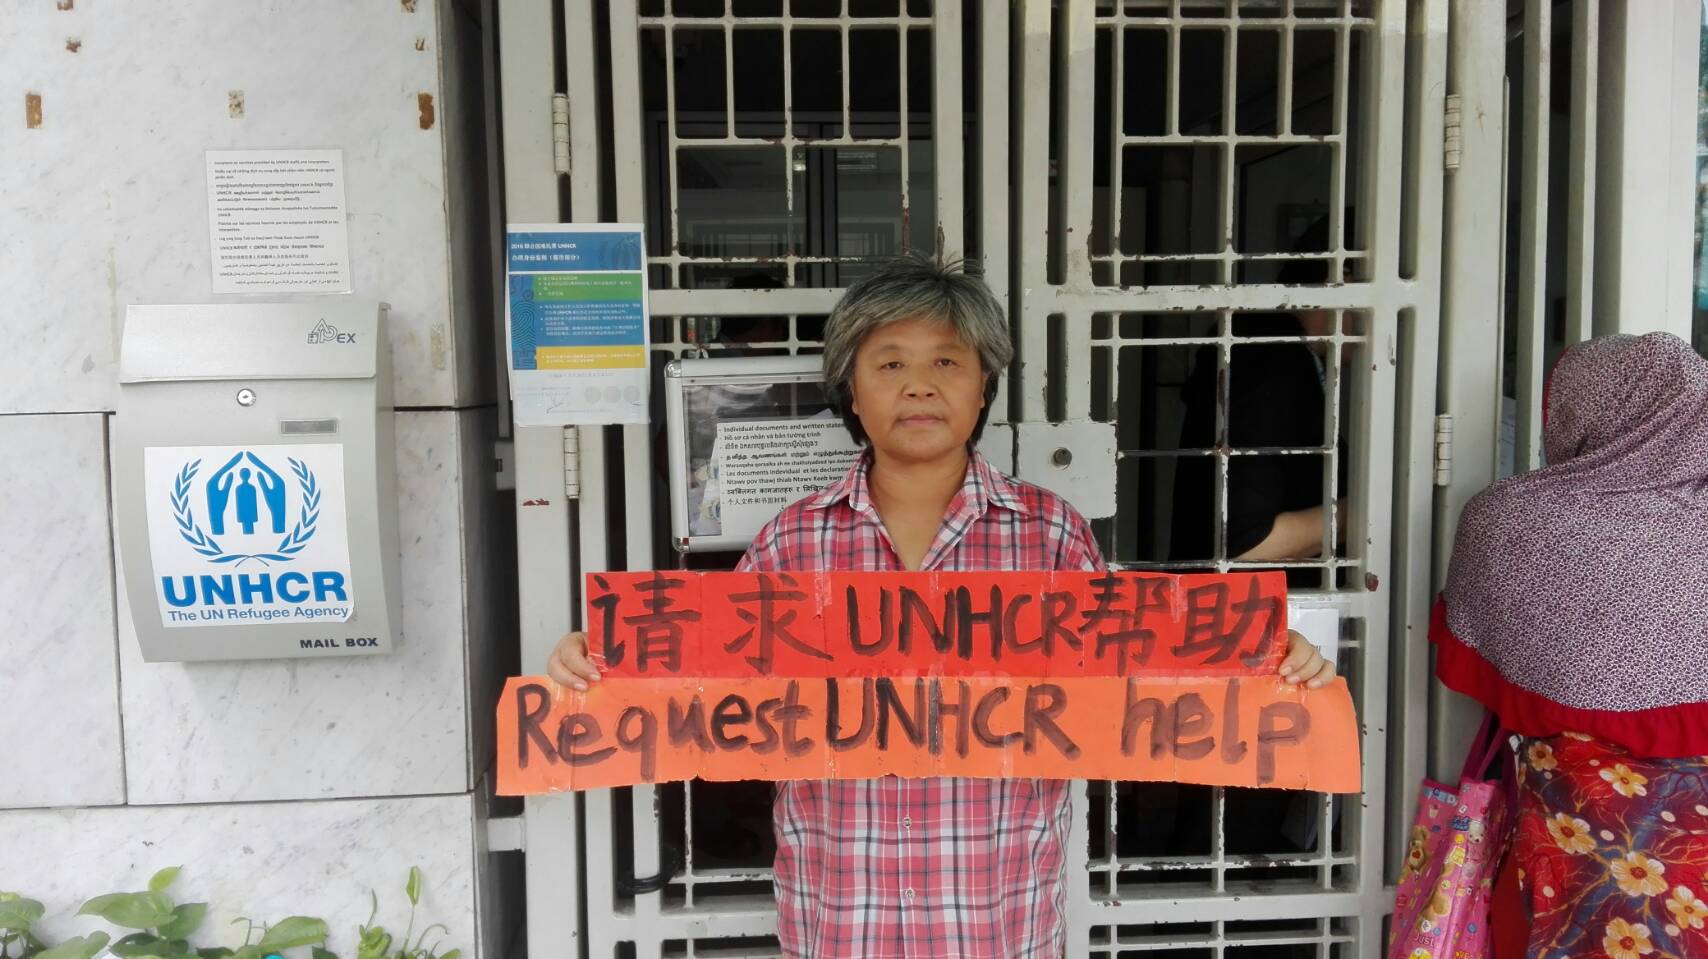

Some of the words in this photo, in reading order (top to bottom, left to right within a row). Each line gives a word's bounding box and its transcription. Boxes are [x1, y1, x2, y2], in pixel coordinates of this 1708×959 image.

[161, 570, 348, 608] UNHCR
[168, 609, 198, 622] The
[200, 608, 224, 620] UN
[227, 607, 290, 621] Refugee
[294, 606, 349, 619] Agency
[299, 638, 340, 649] MAIL
[345, 637, 379, 648] BOX
[517, 678, 816, 783] Request
[825, 677, 1081, 761] UNHCR
[1120, 677, 1312, 784] help
